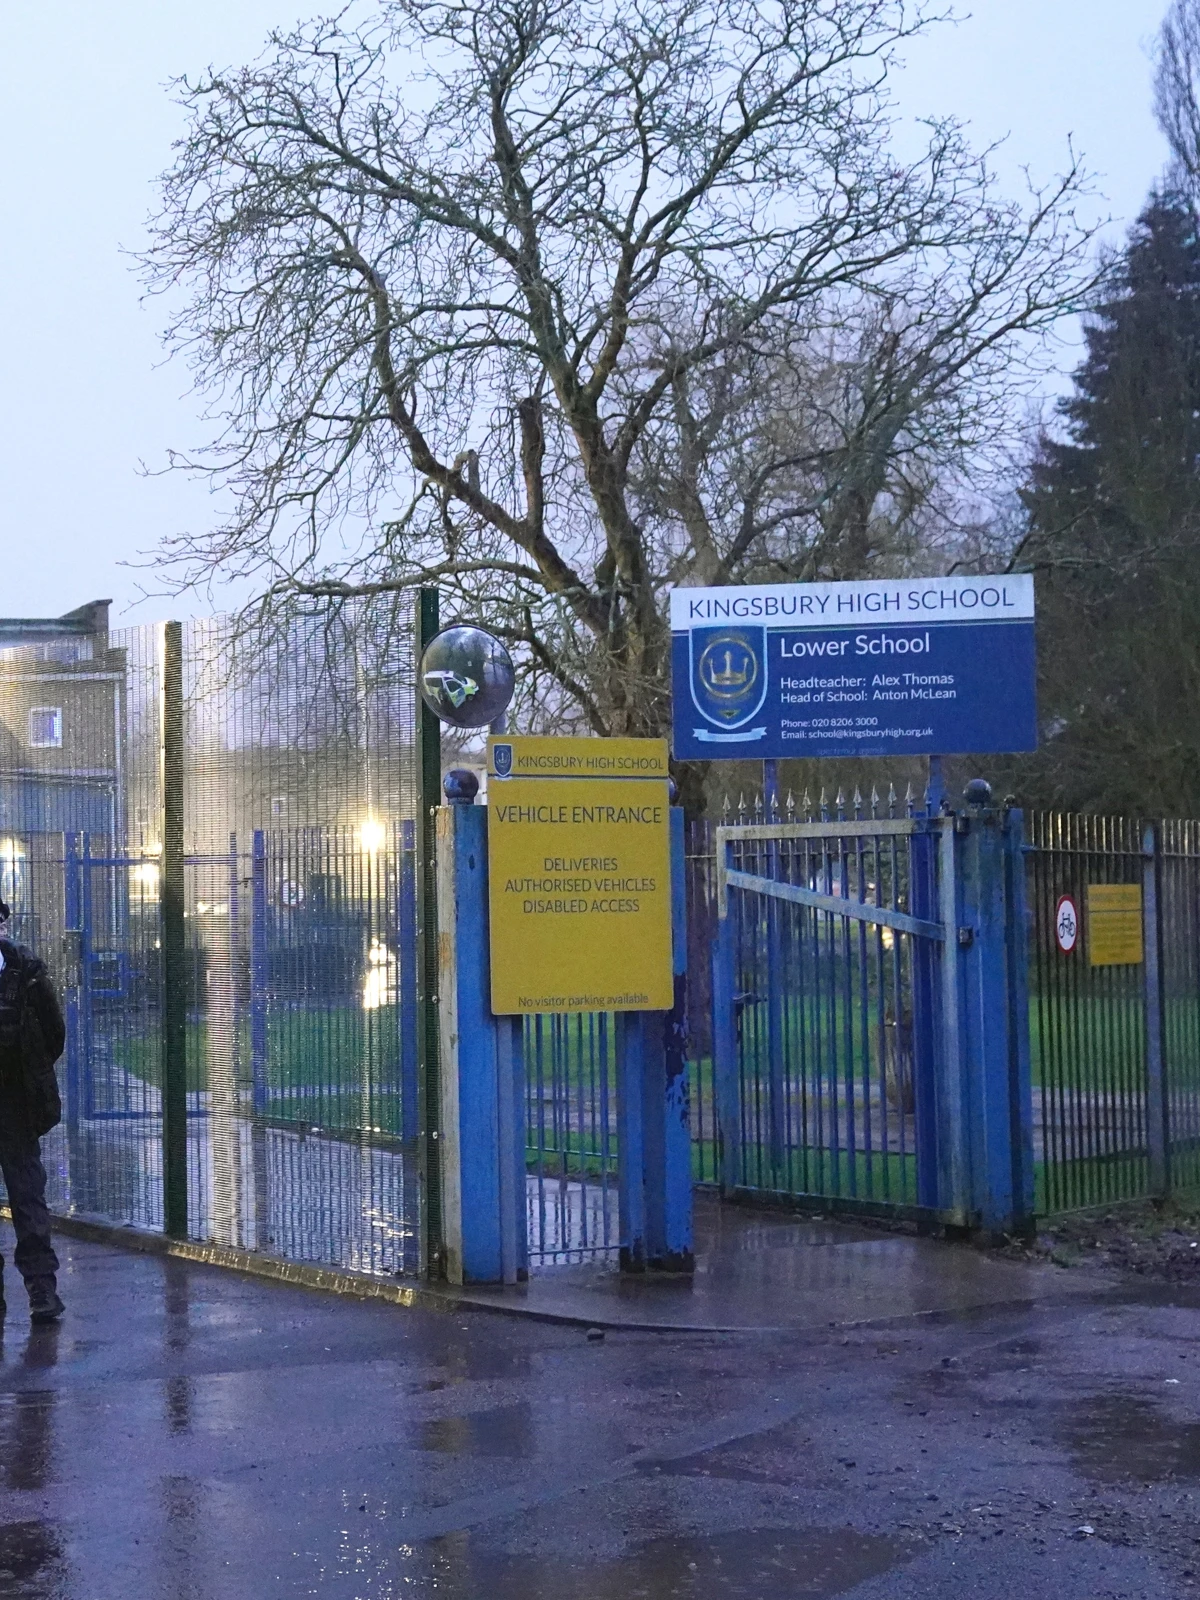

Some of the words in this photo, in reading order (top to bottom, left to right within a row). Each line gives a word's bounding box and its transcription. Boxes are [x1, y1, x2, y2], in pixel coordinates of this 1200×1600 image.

[689, 594, 830, 618] KINGSBURY
[837, 592, 900, 613] HIGH
[907, 587, 1015, 610] SCHOOL
[780, 637, 850, 657] Lower
[855, 632, 930, 655] School
[780, 675, 866, 689] Headteacher:
[871, 674, 900, 687] Alex
[902, 673, 954, 686] Thomas
[780, 692, 810, 703] Head
[812, 691, 824, 702] of
[826, 690, 868, 702] School:
[872, 689, 908, 701] Anton
[910, 688, 957, 700] McLean
[780, 719, 811, 728] Phone:
[811, 718, 829, 727] 020
[780, 730, 807, 739] Email:
[517, 755, 583, 768] KINGSBURY
[586, 757, 615, 769] HIGH
[617, 757, 664, 770] SCHOOL
[496, 805, 567, 823] VEHICLE
[573, 806, 662, 824] ENTRANCE
[544, 858, 618, 872] DELIVERIES
[504, 878, 592, 893] AUTHORISED
[594, 878, 656, 892] VEHICLES
[523, 899, 588, 913] DISABLED
[590, 898, 640, 913] ACCESS
[518, 996, 533, 1007] No
[535, 995, 565, 1007] visitor
[568, 994, 605, 1007] parking
[606, 993, 649, 1005] available
